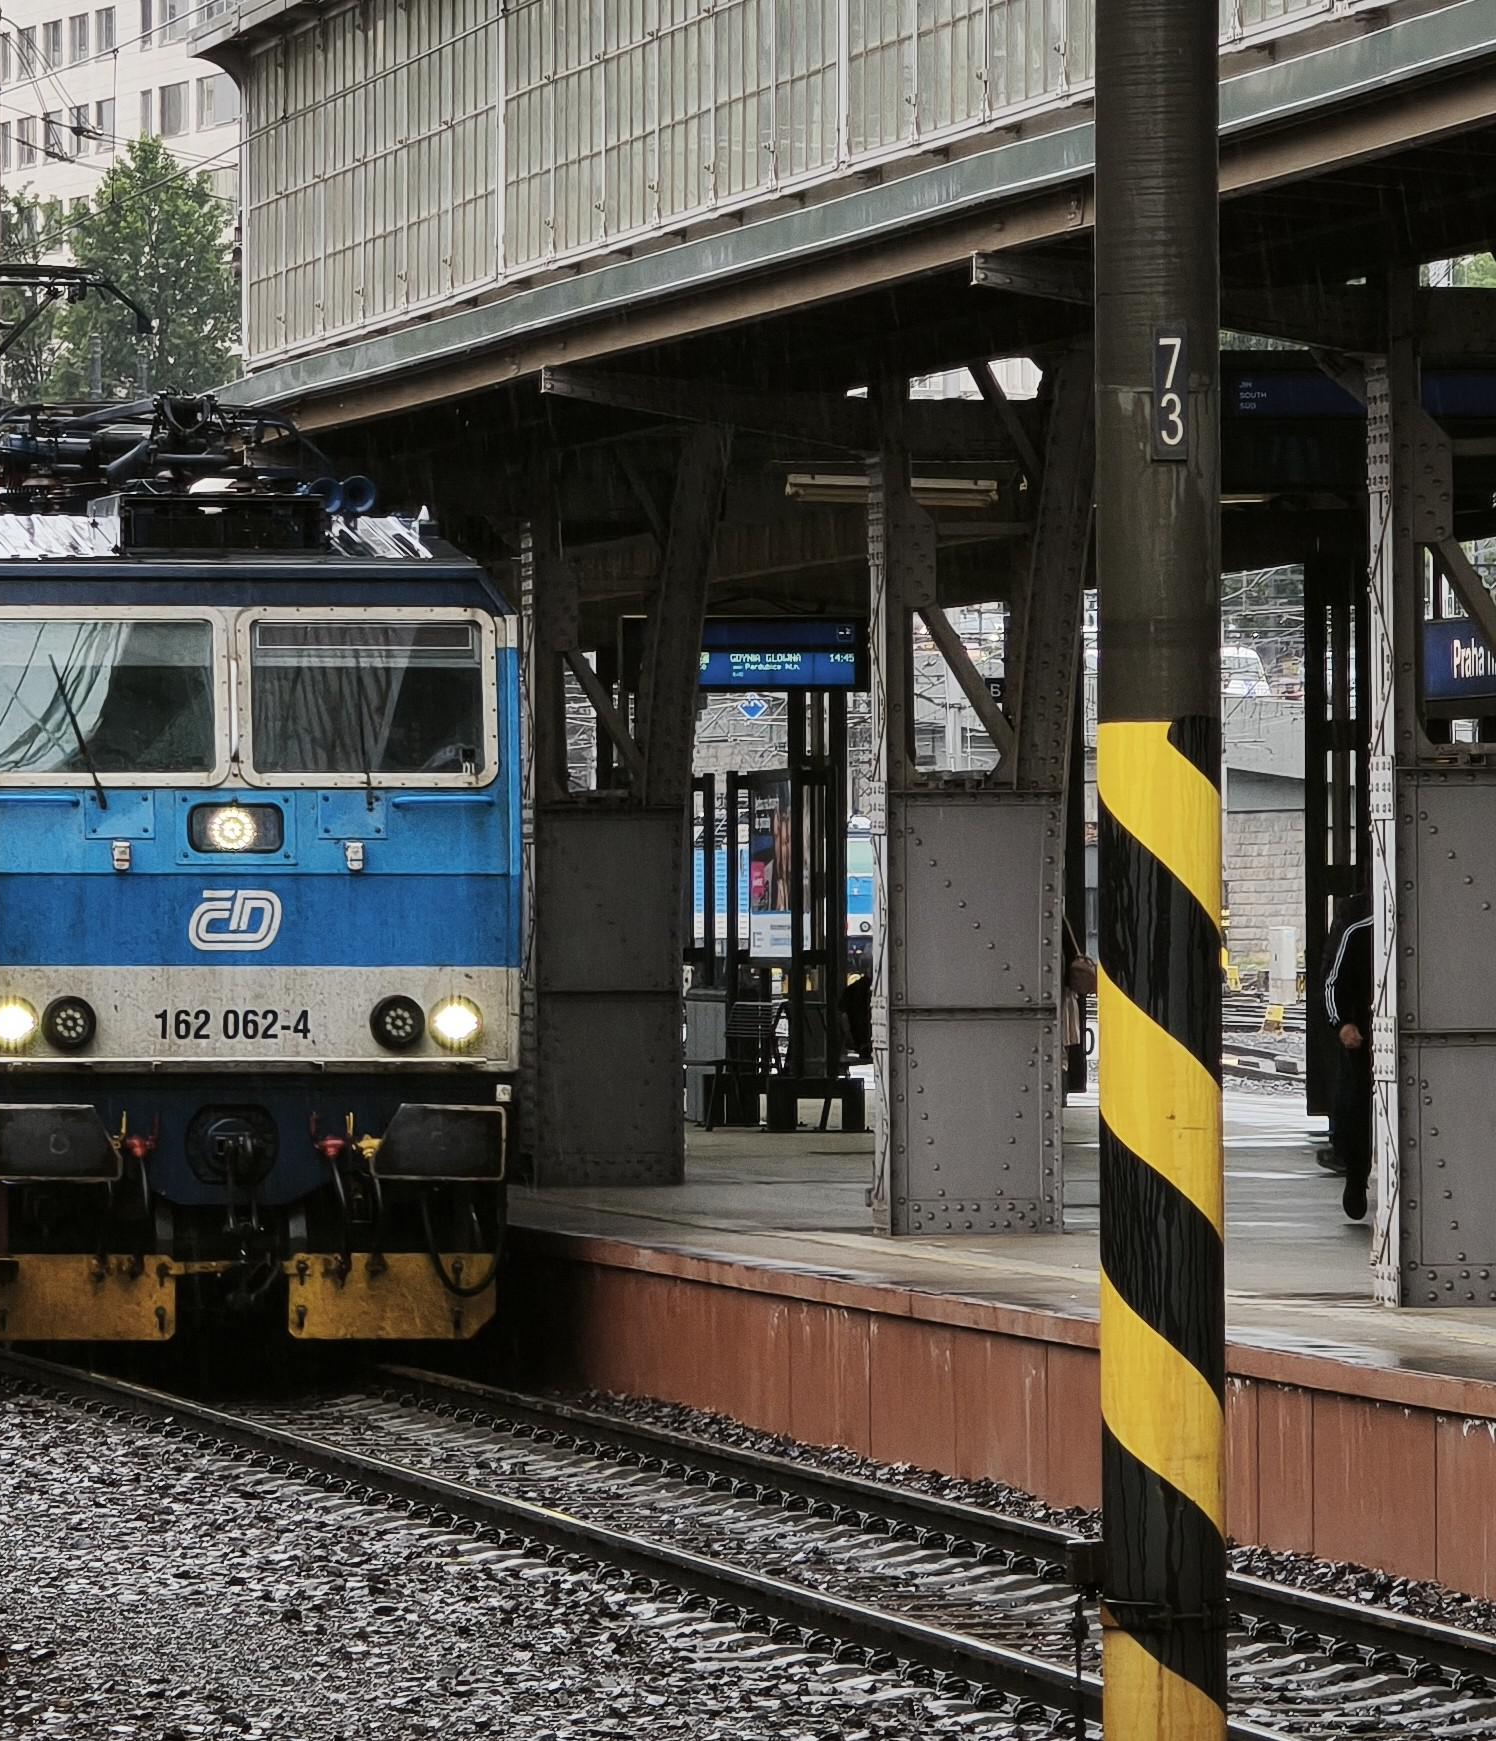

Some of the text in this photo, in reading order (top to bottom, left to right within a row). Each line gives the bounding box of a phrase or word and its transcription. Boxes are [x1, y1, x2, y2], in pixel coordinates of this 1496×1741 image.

[1159, 337, 1184, 446] 73
[829, 653, 855, 663] 14:45
[1453, 637, 1485, 679] Praha
[154, 1009, 311, 1040] 162 062-4
